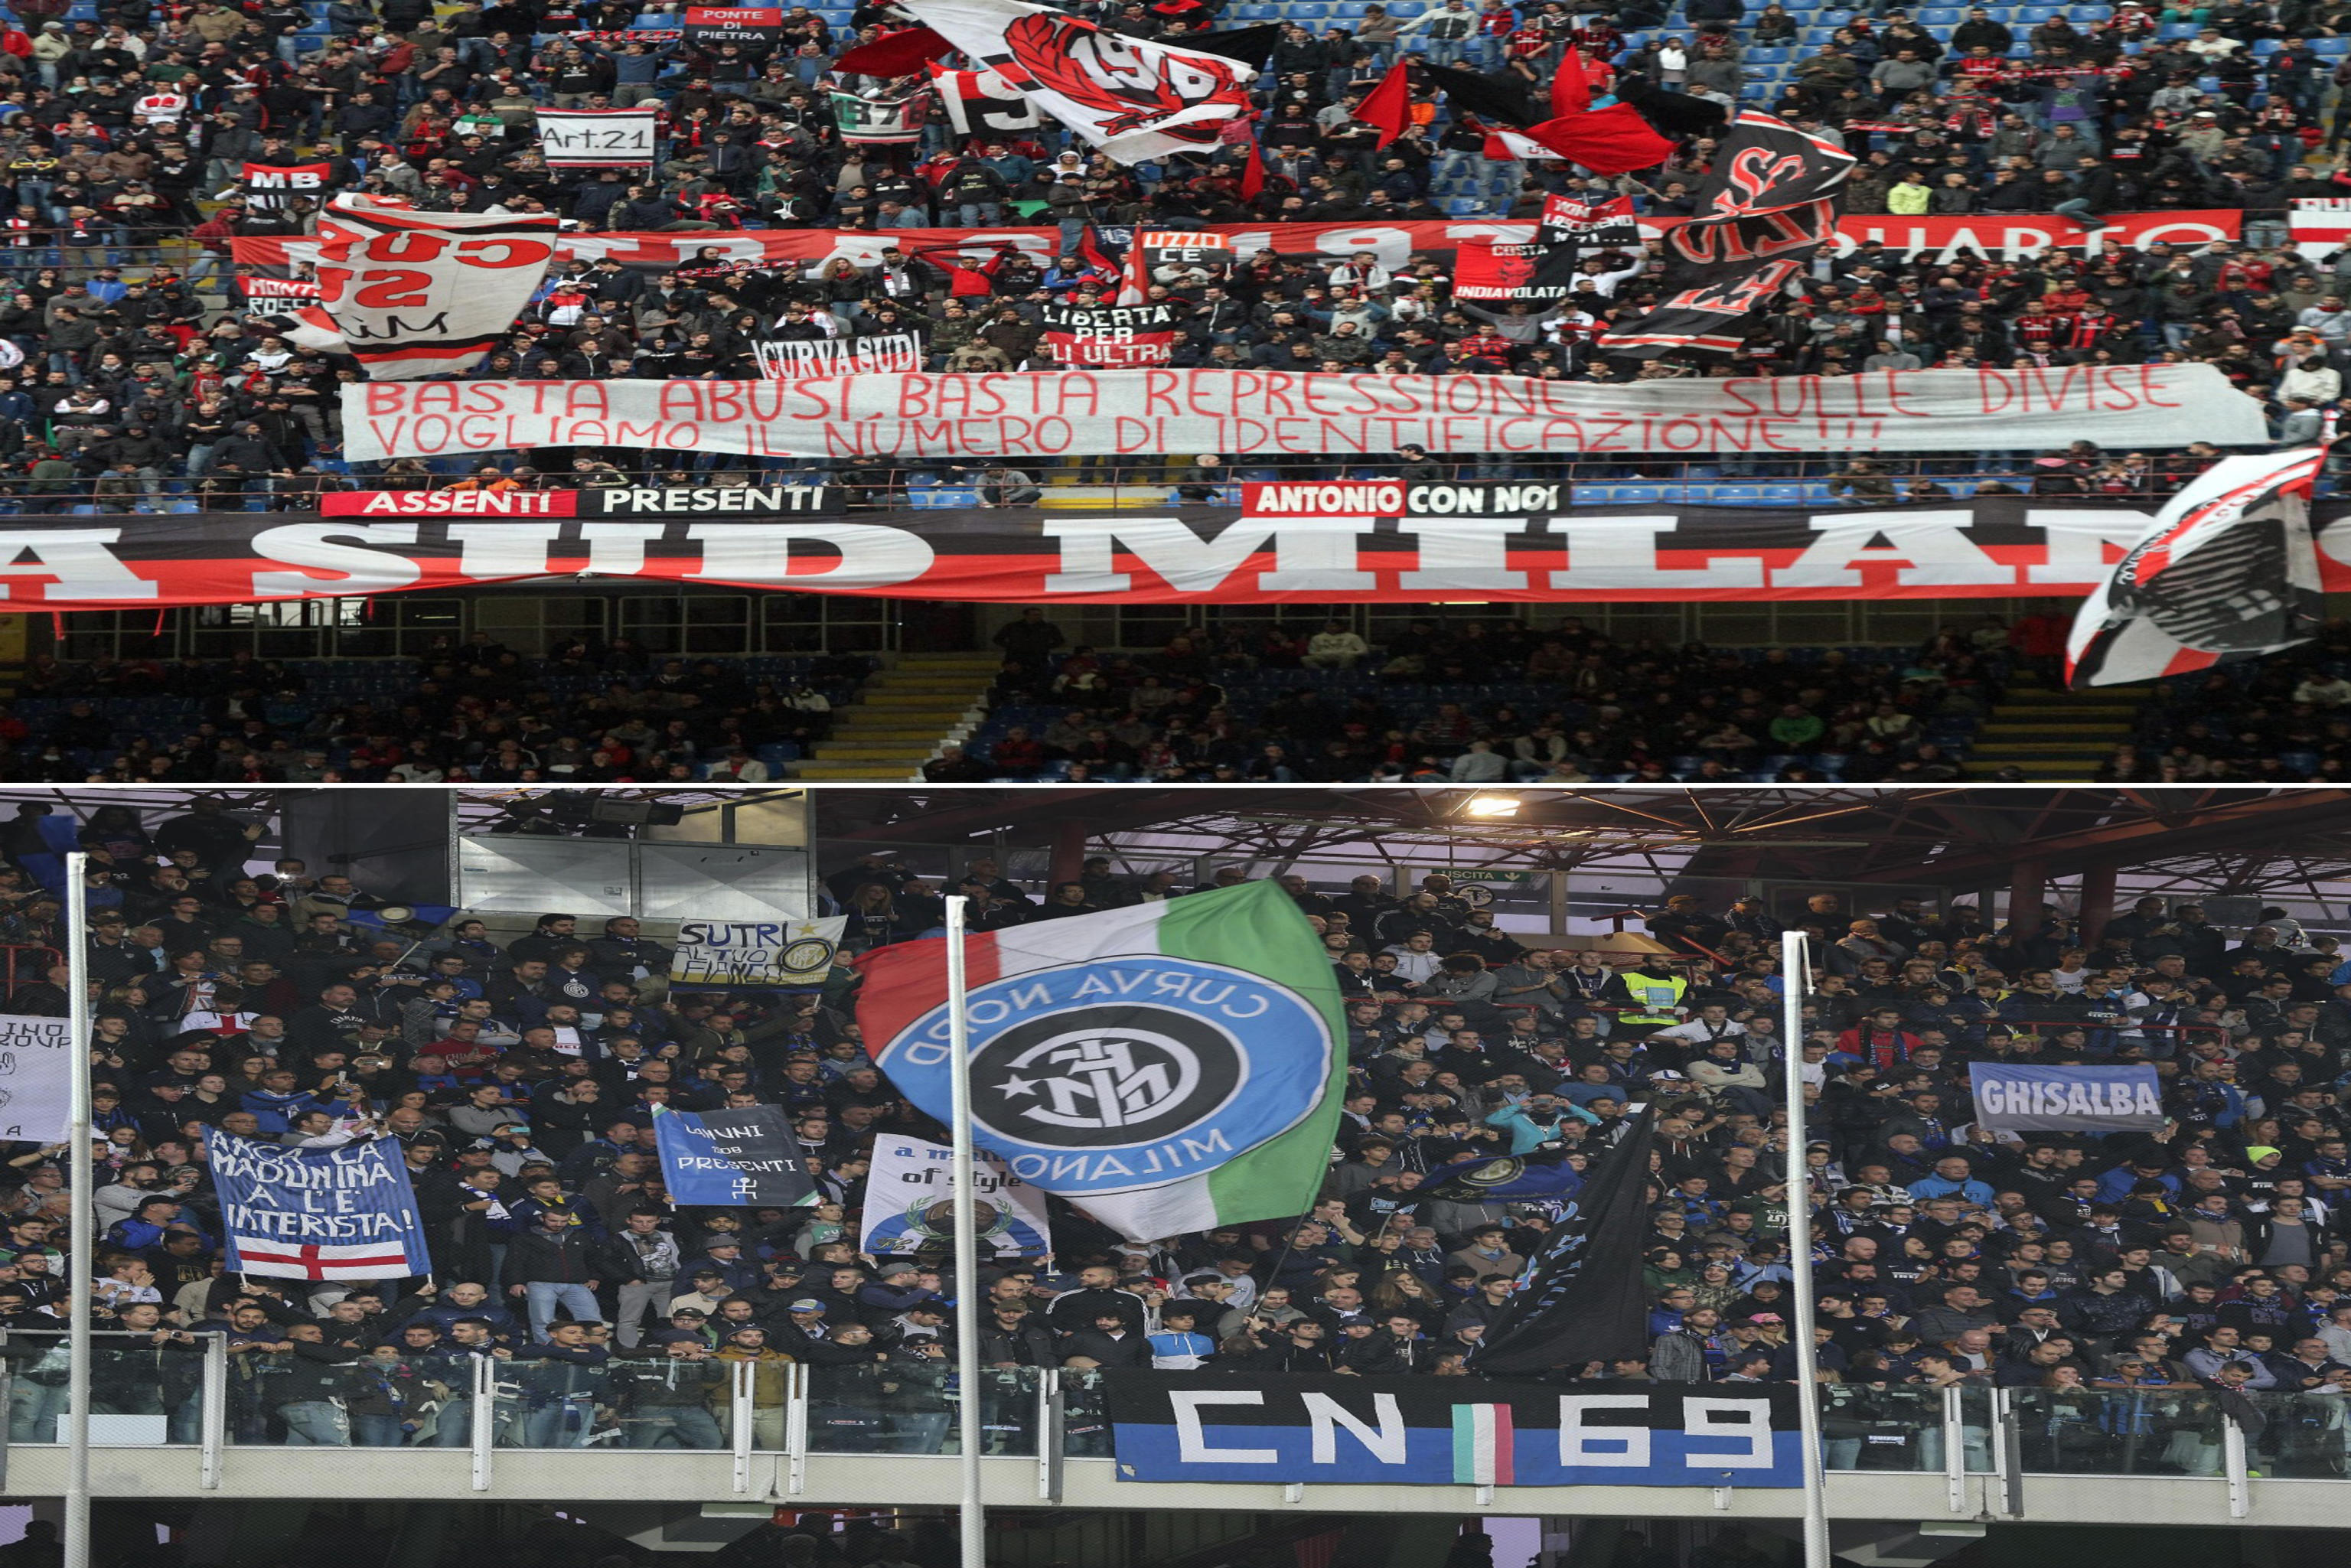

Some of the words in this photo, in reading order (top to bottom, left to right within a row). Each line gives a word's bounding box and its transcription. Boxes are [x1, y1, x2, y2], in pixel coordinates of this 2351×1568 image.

[703, 10, 764, 20] PONTE
[722, 21, 742, 31] DI
[697, 31, 765, 40] PIETRA
[543, 127, 651, 149] Art.21
[250, 171, 322, 189] MB
[1492, 244, 1549, 256] COSTA
[1455, 285, 1567, 298] INDIAVOLATA
[1074, 327, 1133, 345] PER
[761, 338, 856, 380] CURVA
[856, 334, 914, 374] SUD
[366, 380, 610, 421] BASTA
[899, 370, 1097, 421] BASTA
[1722, 367, 1929, 418] SULLE
[1978, 362, 2183, 415] DIVISE
[367, 413, 700, 457] VOGLIAMO
[745, 423, 791, 458] IL
[823, 415, 1072, 458] NUMERO
[1114, 416, 1165, 455] DI
[362, 491, 551, 514] ASSENTI
[603, 486, 824, 513] PRESENTI
[1256, 484, 1402, 513] ANTONIO
[1408, 484, 1484, 513] CON
[251, 523, 934, 598] SUD
[1441, 869, 1495, 880] USCITA
[677, 921, 788, 948] SUTRI
[1981, 1079, 2162, 1115] GHISALBA
[212, 1149, 397, 1189] MADUNINA
[678, 1156, 797, 1173] PRESENTI
[902, 1167, 943, 1185] of
[946, 1171, 1022, 1194] tyle
[245, 1183, 279, 1208] A
[1169, 1390, 1407, 1465] CN
[1559, 1394, 1774, 1469] 69
